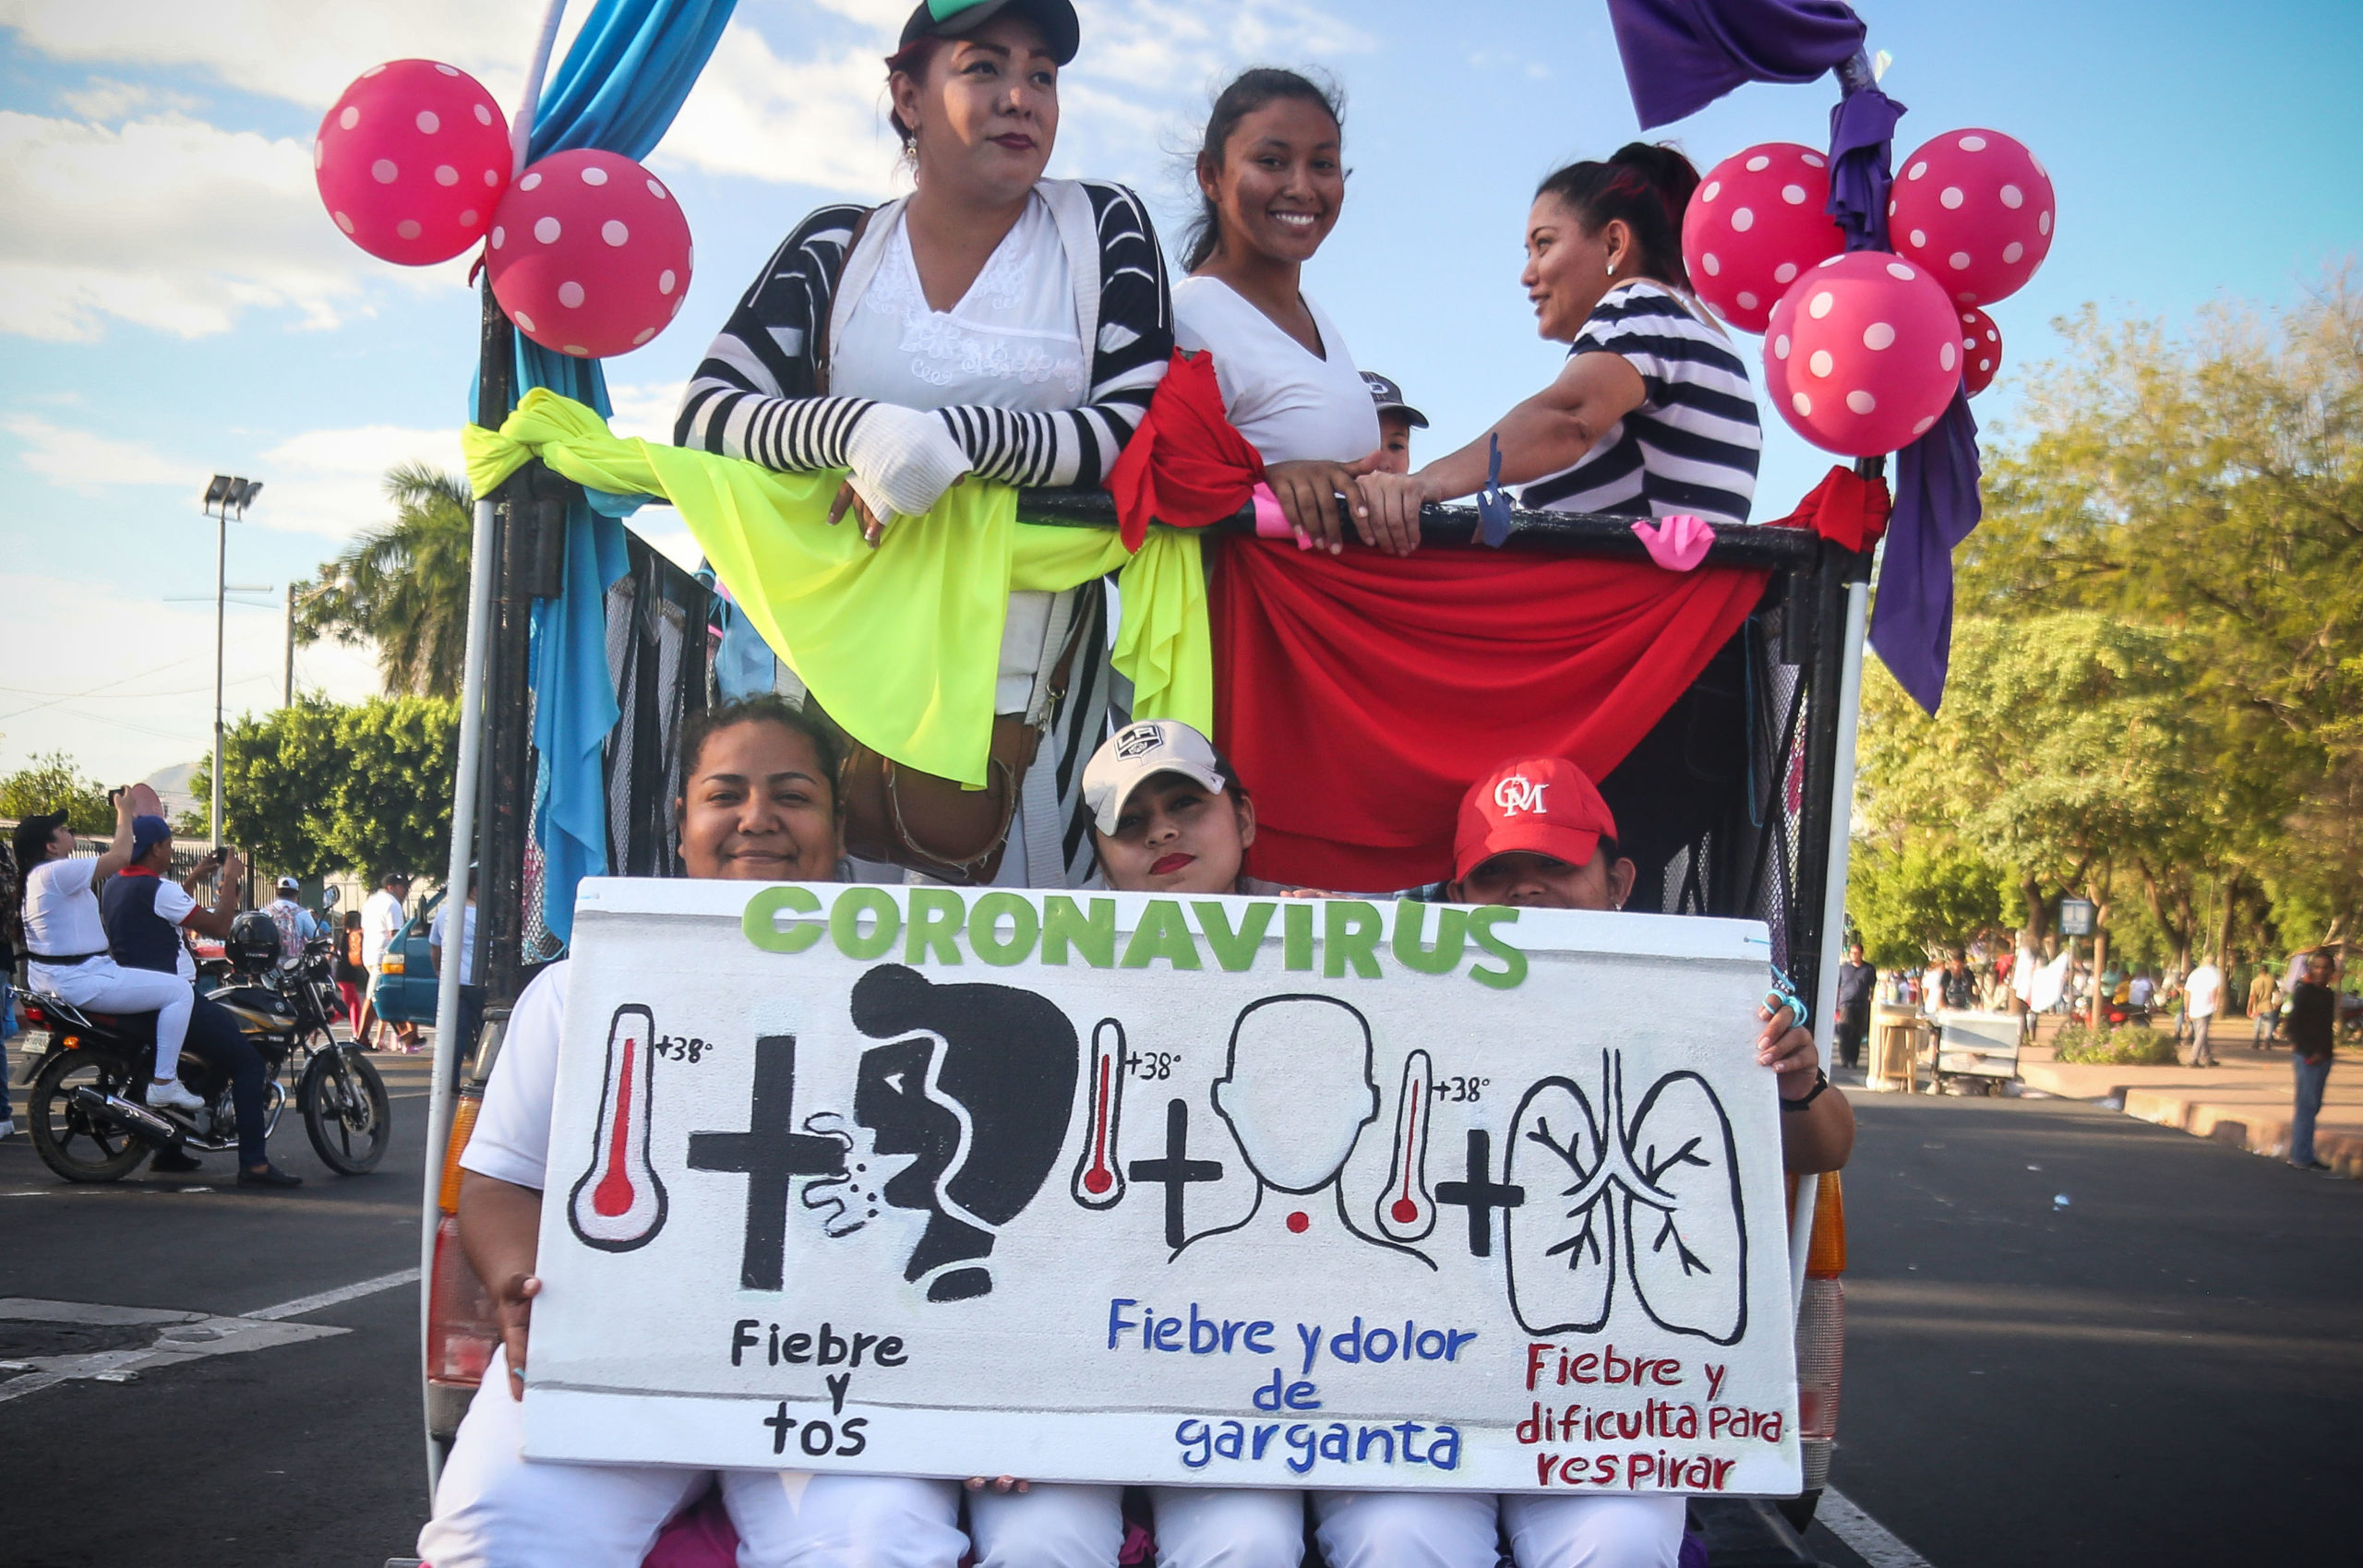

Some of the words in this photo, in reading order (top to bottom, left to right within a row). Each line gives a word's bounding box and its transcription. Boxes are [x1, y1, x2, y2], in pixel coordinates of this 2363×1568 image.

[741, 885, 1529, 989] CORONAVIRUS
[731, 1319, 909, 1367] Fiebre
[1108, 1299, 1275, 1354] Fiebre
[1297, 1323, 1322, 1374] y
[1330, 1316, 1478, 1364] dolor
[825, 1371, 851, 1416] y
[1253, 1368, 1322, 1411] de
[1526, 1343, 1683, 1391] Fiebre
[1705, 1363, 1725, 1402] y
[763, 1401, 870, 1456] tos
[1175, 1418, 1461, 1473] garganta
[1516, 1397, 1697, 1444] dificulta
